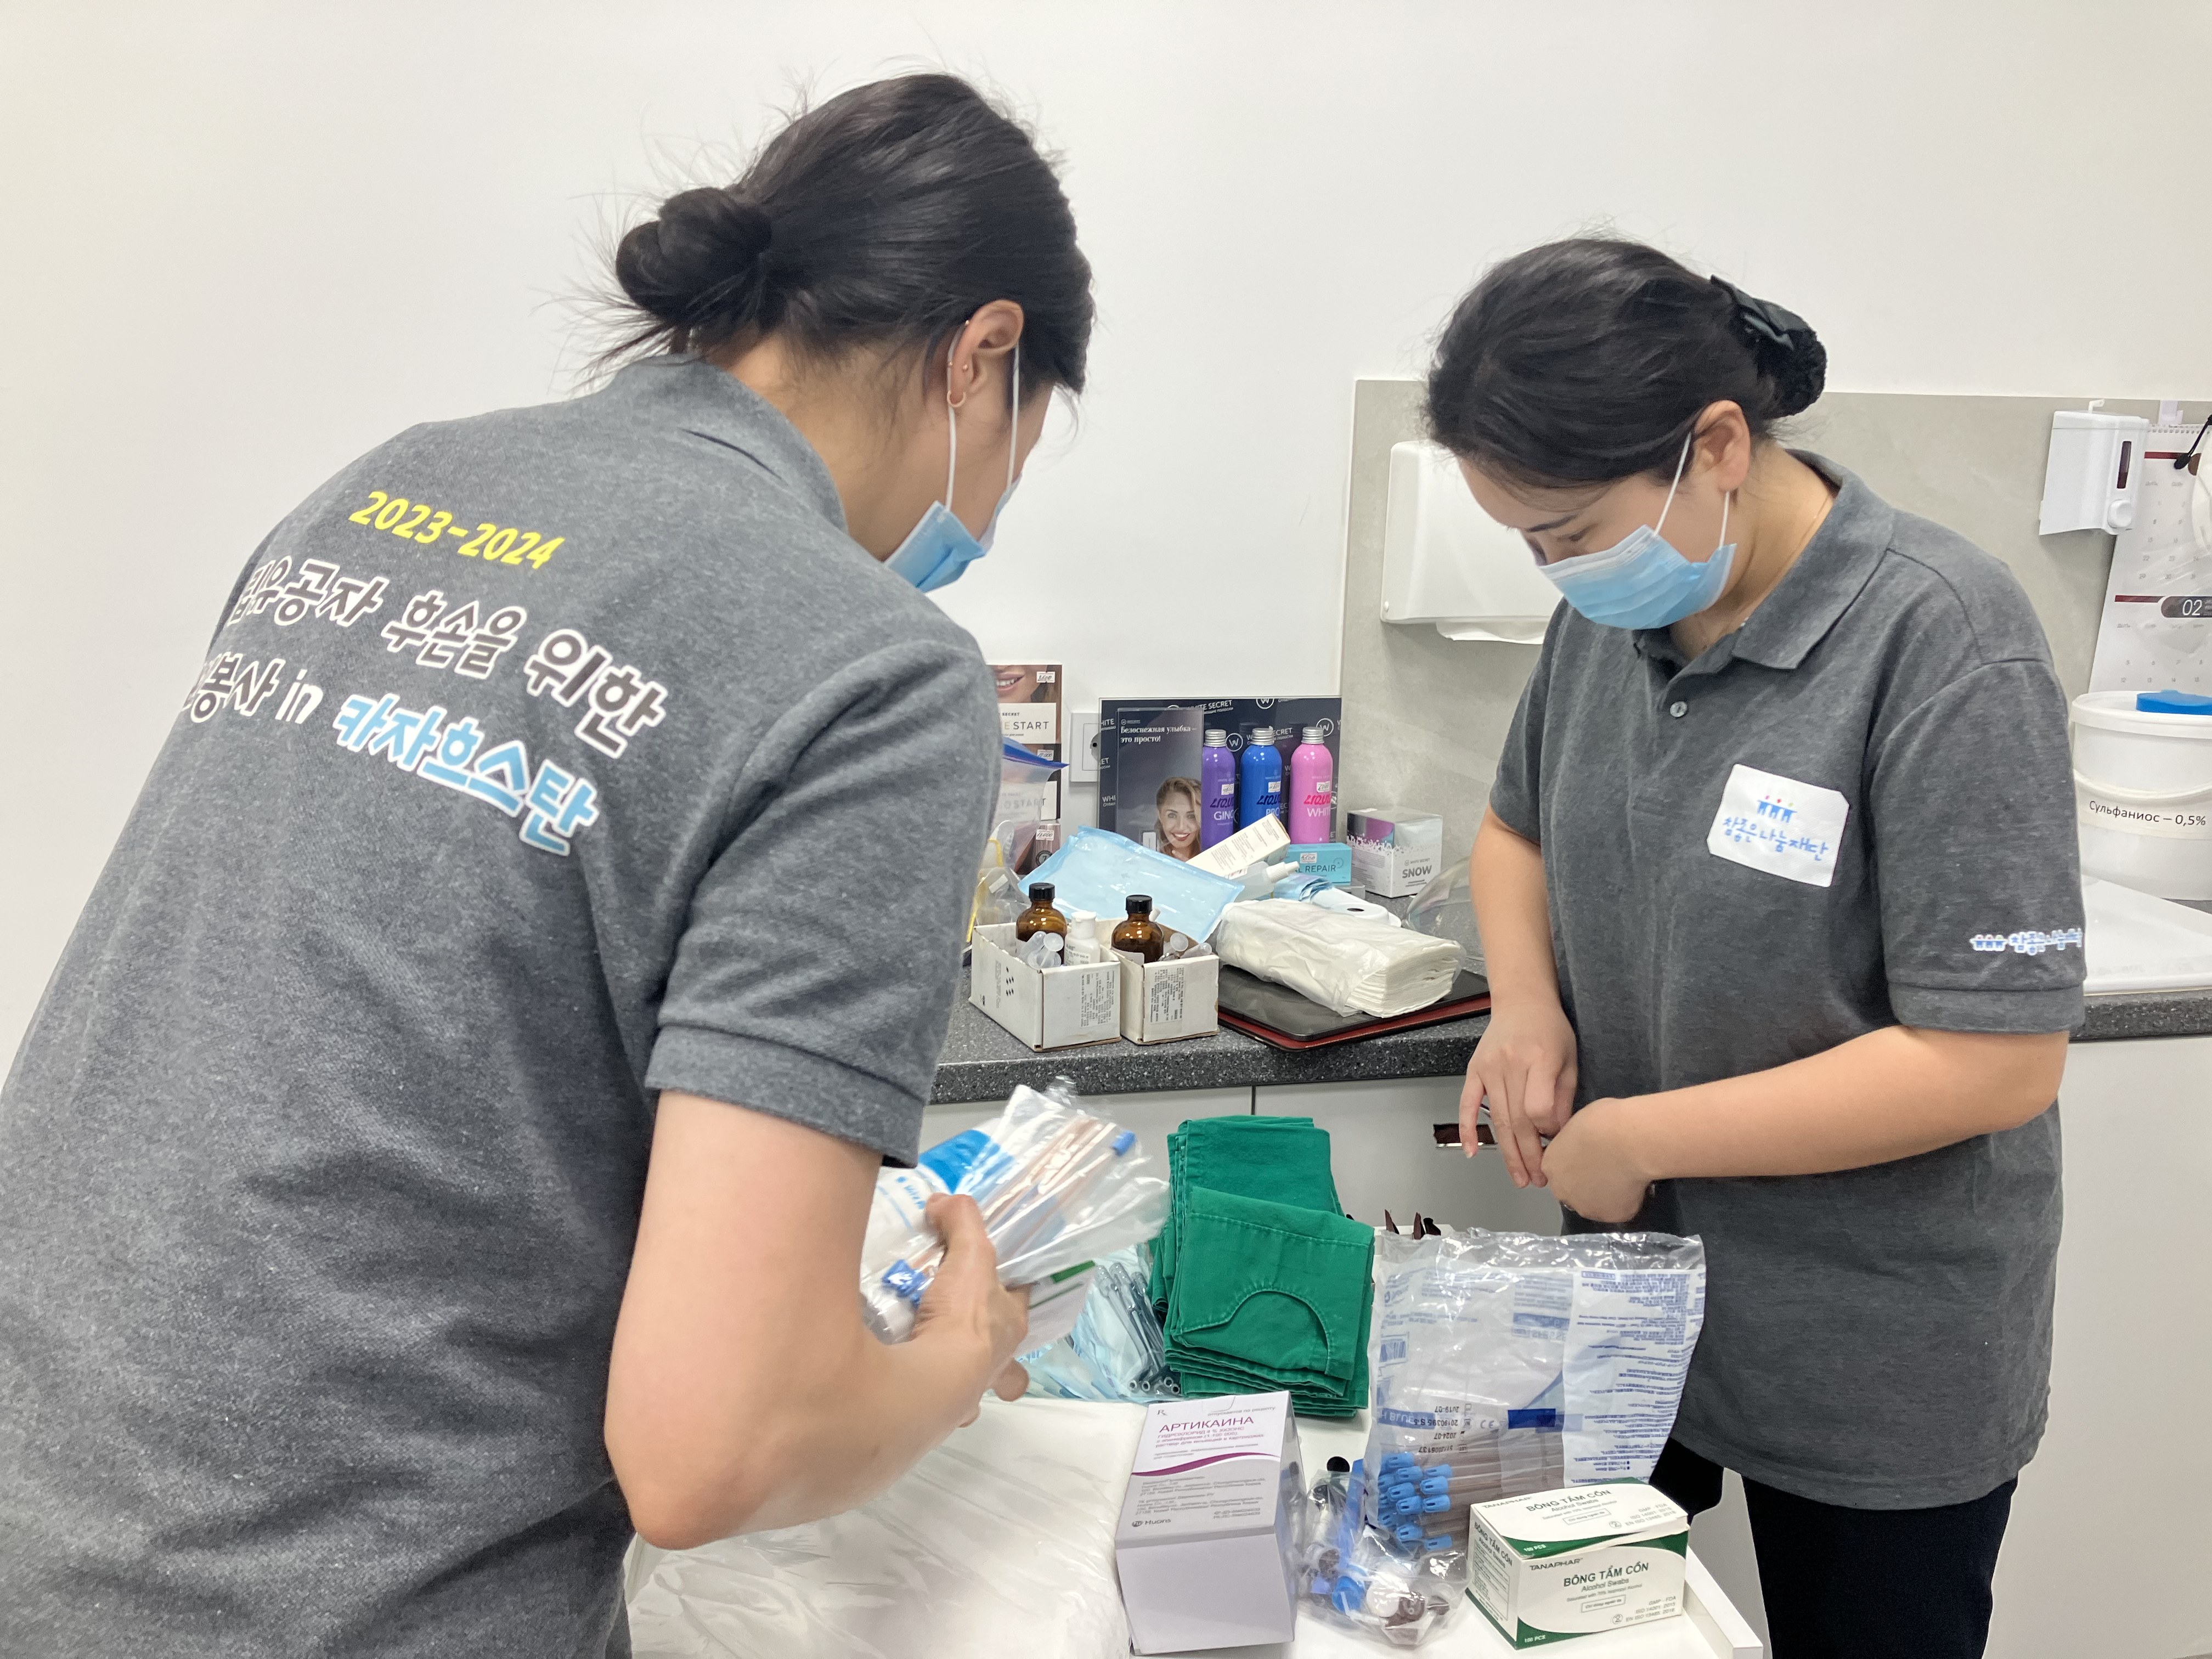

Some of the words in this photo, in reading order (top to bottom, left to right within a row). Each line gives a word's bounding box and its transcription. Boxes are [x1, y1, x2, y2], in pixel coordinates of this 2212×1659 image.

[348, 492, 565, 568] 2023-2024
[2182, 599, 2203, 616] 02
[381, 590, 527, 679] 후손을
[524, 628, 667, 759] 위한
[1208, 699, 1233, 709] SECRET
[1013, 721, 1049, 730] START
[1120, 726, 1165, 734] Белоснежная
[1133, 735, 1161, 744] просто!
[274, 669, 324, 724] in
[332, 692, 599, 856] 카자흐스탄
[2089, 800, 2160, 822] Сульфаниос
[2175, 814, 2206, 827] 0,5%
[1305, 865, 1336, 873] REPAIR
[1402, 865, 1432, 878] SNOW
[1159, 1416, 1254, 1433] АРТИКАИНА
[1482, 1497, 1530, 1509] TANAPHAR
[1530, 1558, 1581, 1571] TANAPHAR
[1563, 1573, 1596, 1587] BÔNG
[1581, 1583, 1606, 1592] Alcohol
[1607, 1577, 1629, 1587] Swabs
